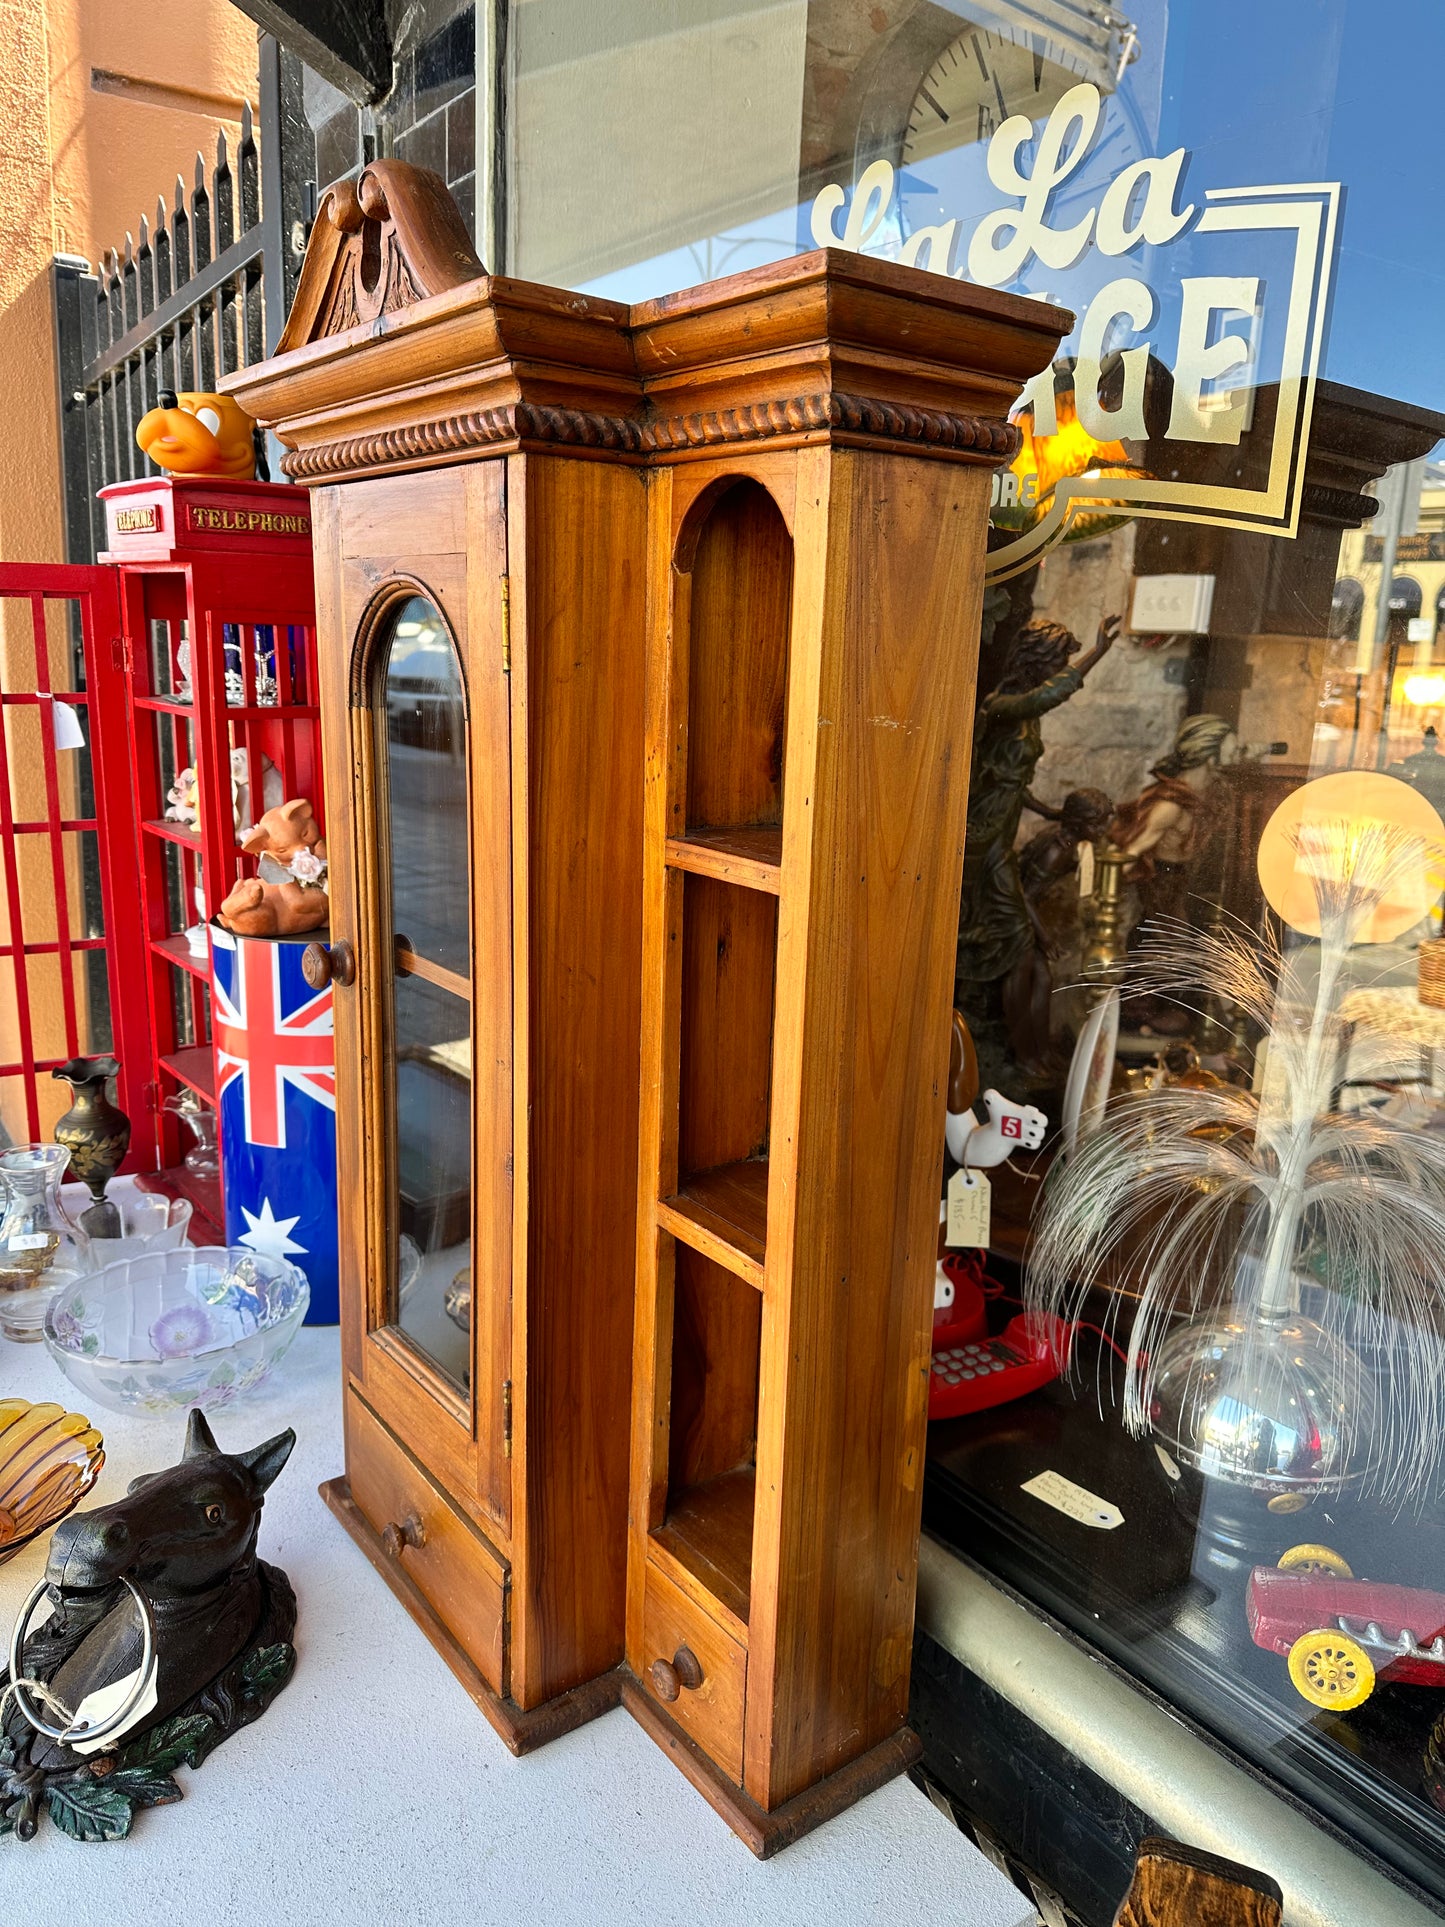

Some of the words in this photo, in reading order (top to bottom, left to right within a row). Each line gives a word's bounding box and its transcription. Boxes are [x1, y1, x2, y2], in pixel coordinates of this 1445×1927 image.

[967, 82, 1195, 287] La
[116, 508, 154, 532] TELEPHONE
[193, 507, 310, 534] TELEPHONE
[1004, 1118, 1018, 1137] 5
